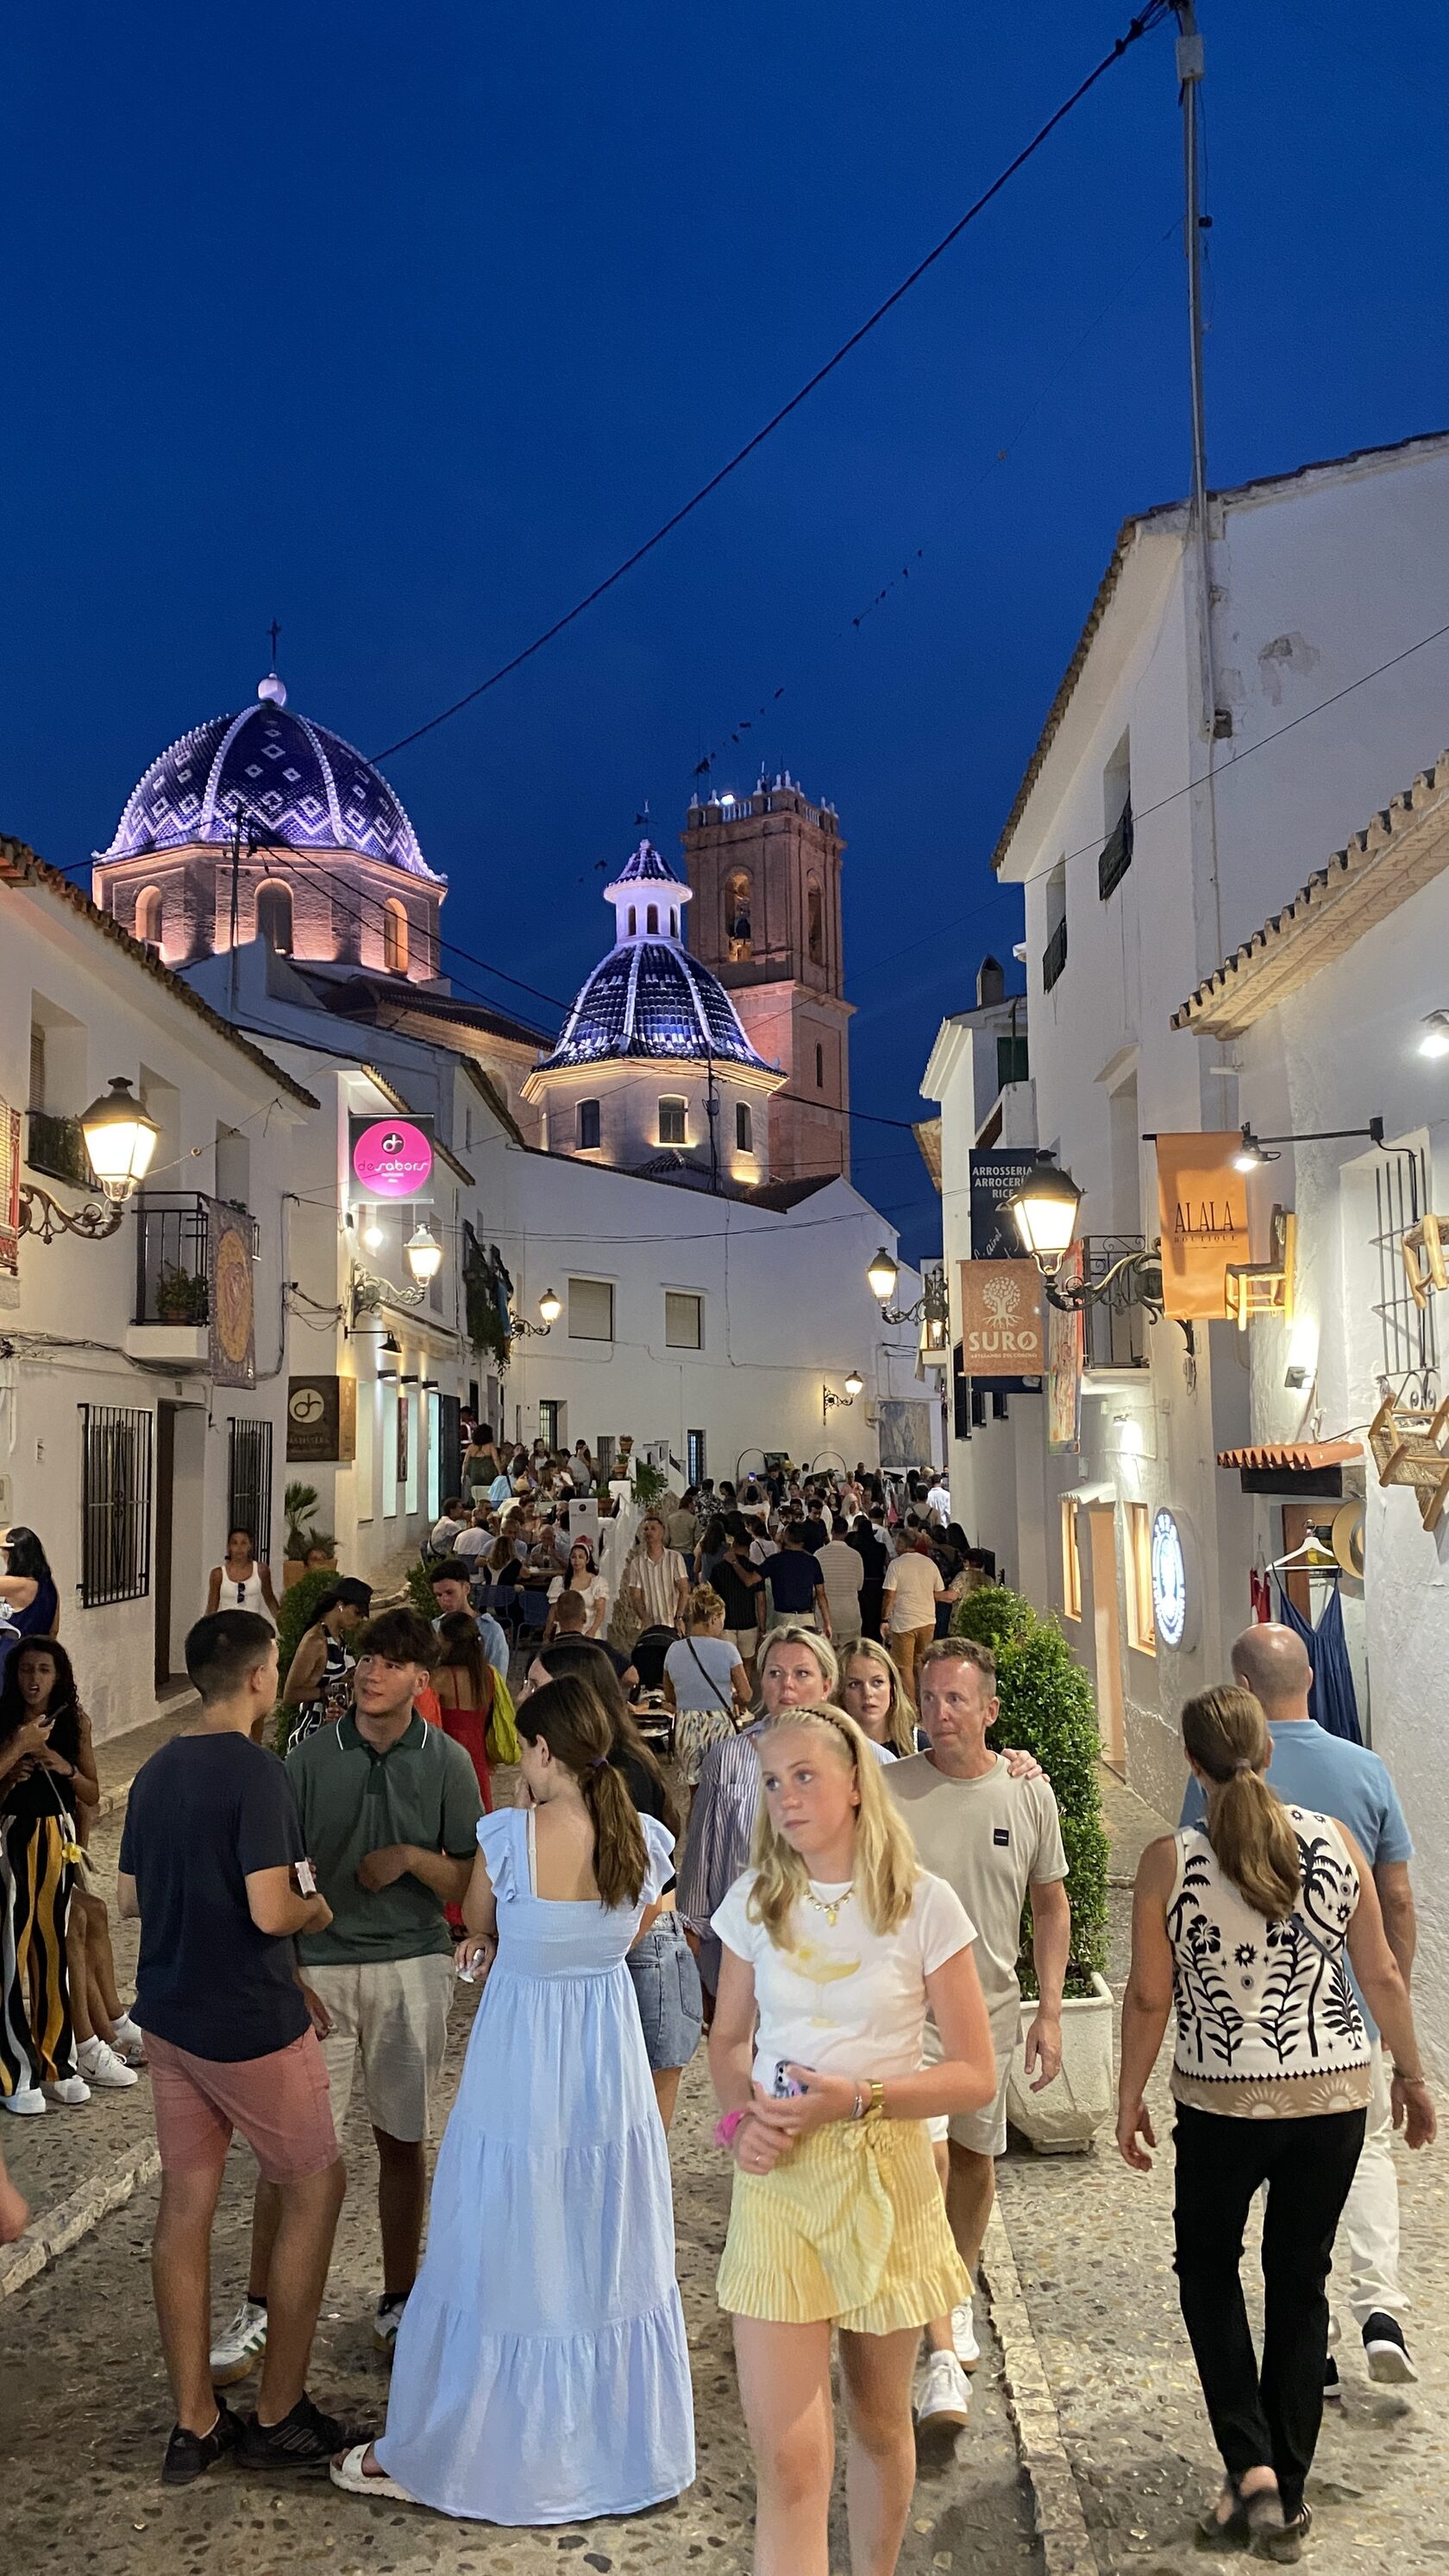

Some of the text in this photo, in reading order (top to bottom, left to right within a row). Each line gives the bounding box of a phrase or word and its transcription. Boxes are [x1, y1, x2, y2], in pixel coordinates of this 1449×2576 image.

[972, 1166, 1032, 1176] ARROSSERIA
[992, 1189, 1014, 1198] RICE
[1175, 1200, 1234, 1234] ALALA
[969, 1330, 1038, 1352] SURO
